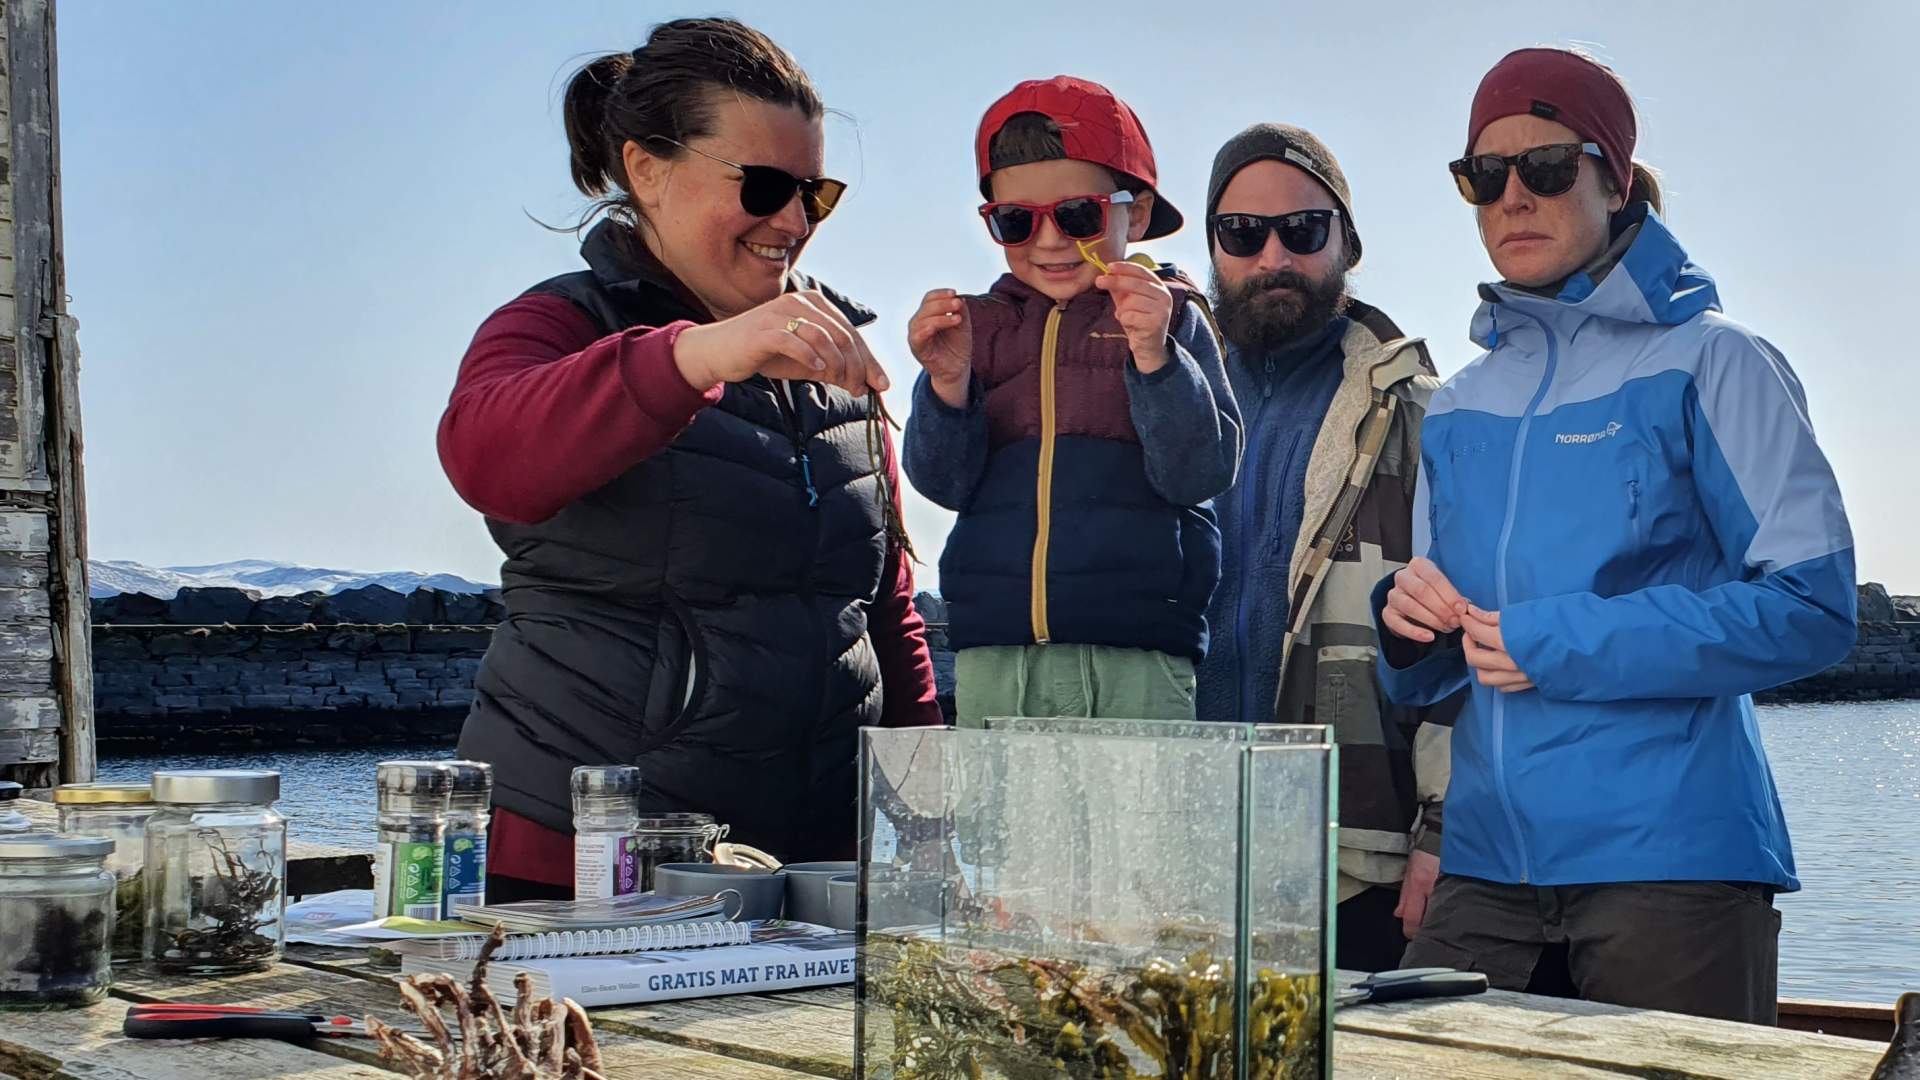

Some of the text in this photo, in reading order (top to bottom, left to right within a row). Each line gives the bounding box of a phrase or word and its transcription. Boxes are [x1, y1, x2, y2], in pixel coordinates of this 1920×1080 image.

[648, 970, 716, 991] GRATIS
[721, 966, 759, 985] MAT
[765, 963, 799, 981] FRA
